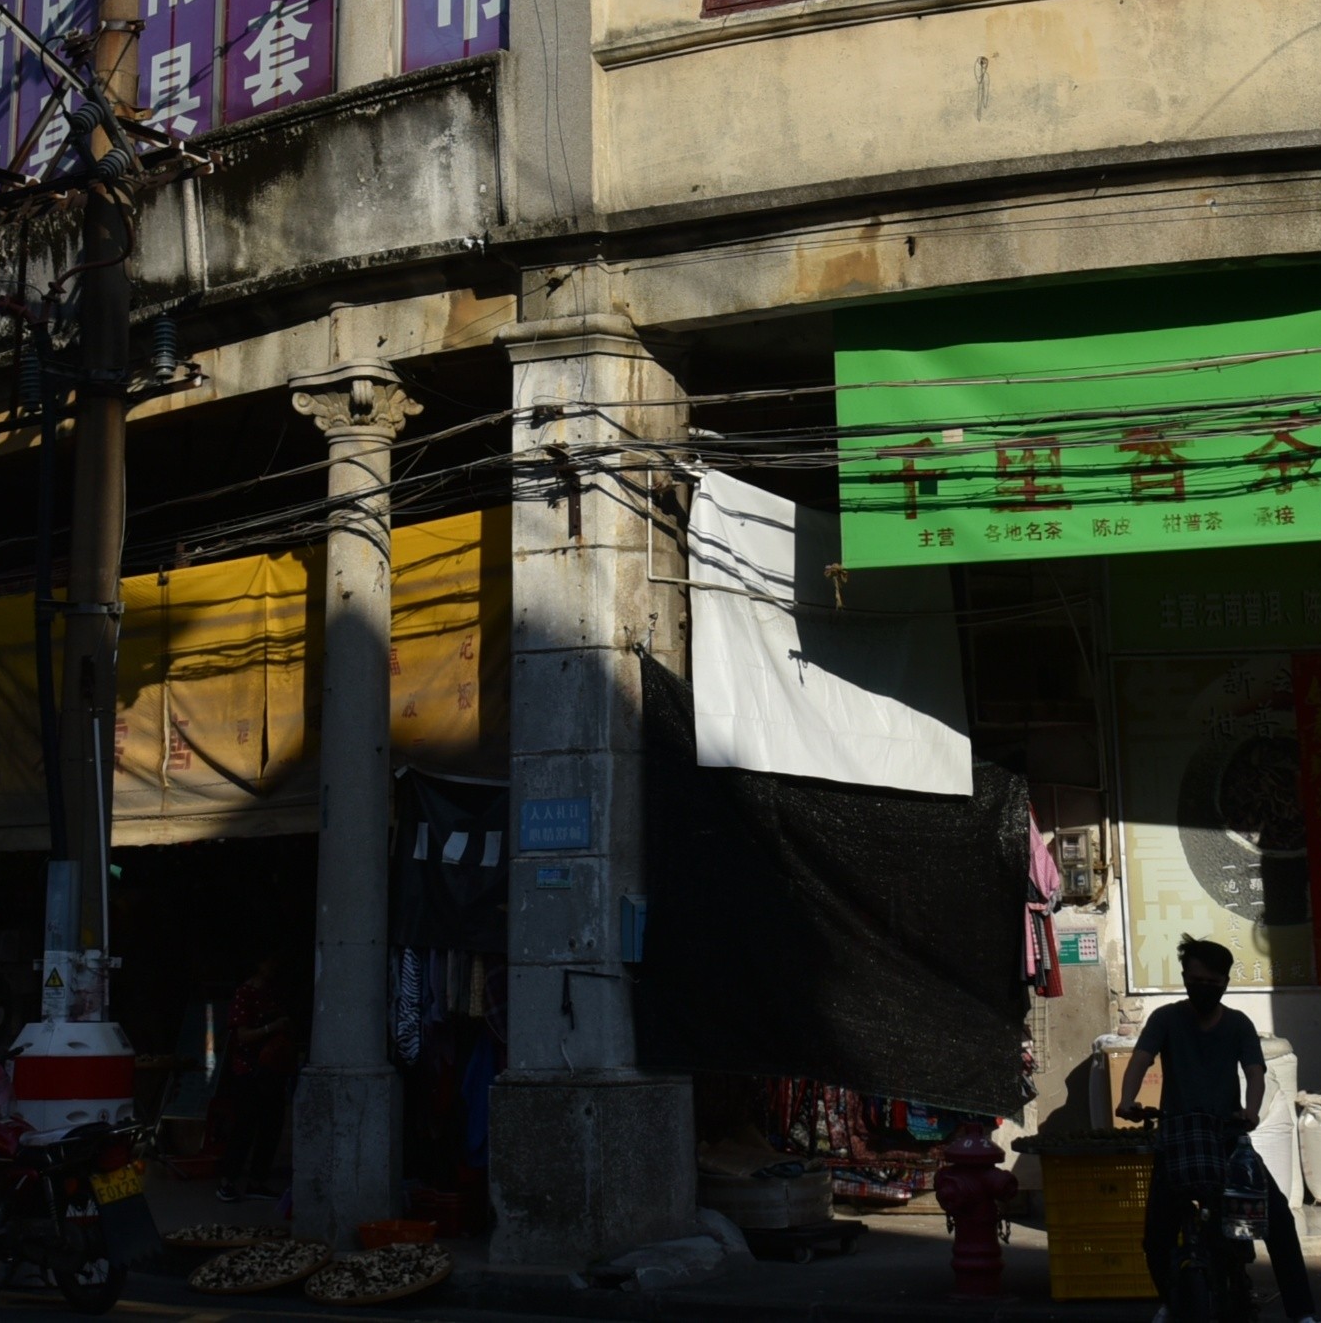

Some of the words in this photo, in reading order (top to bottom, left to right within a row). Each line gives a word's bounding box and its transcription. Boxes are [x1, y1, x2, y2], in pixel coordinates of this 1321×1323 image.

[917, 527, 955, 548] 主营
[983, 521, 1063, 544] 各地名茶
[1092, 517, 1132, 539] 陈皮
[1162, 510, 1223, 534] 柑普茶
[1253, 504, 1296, 527] 承接
